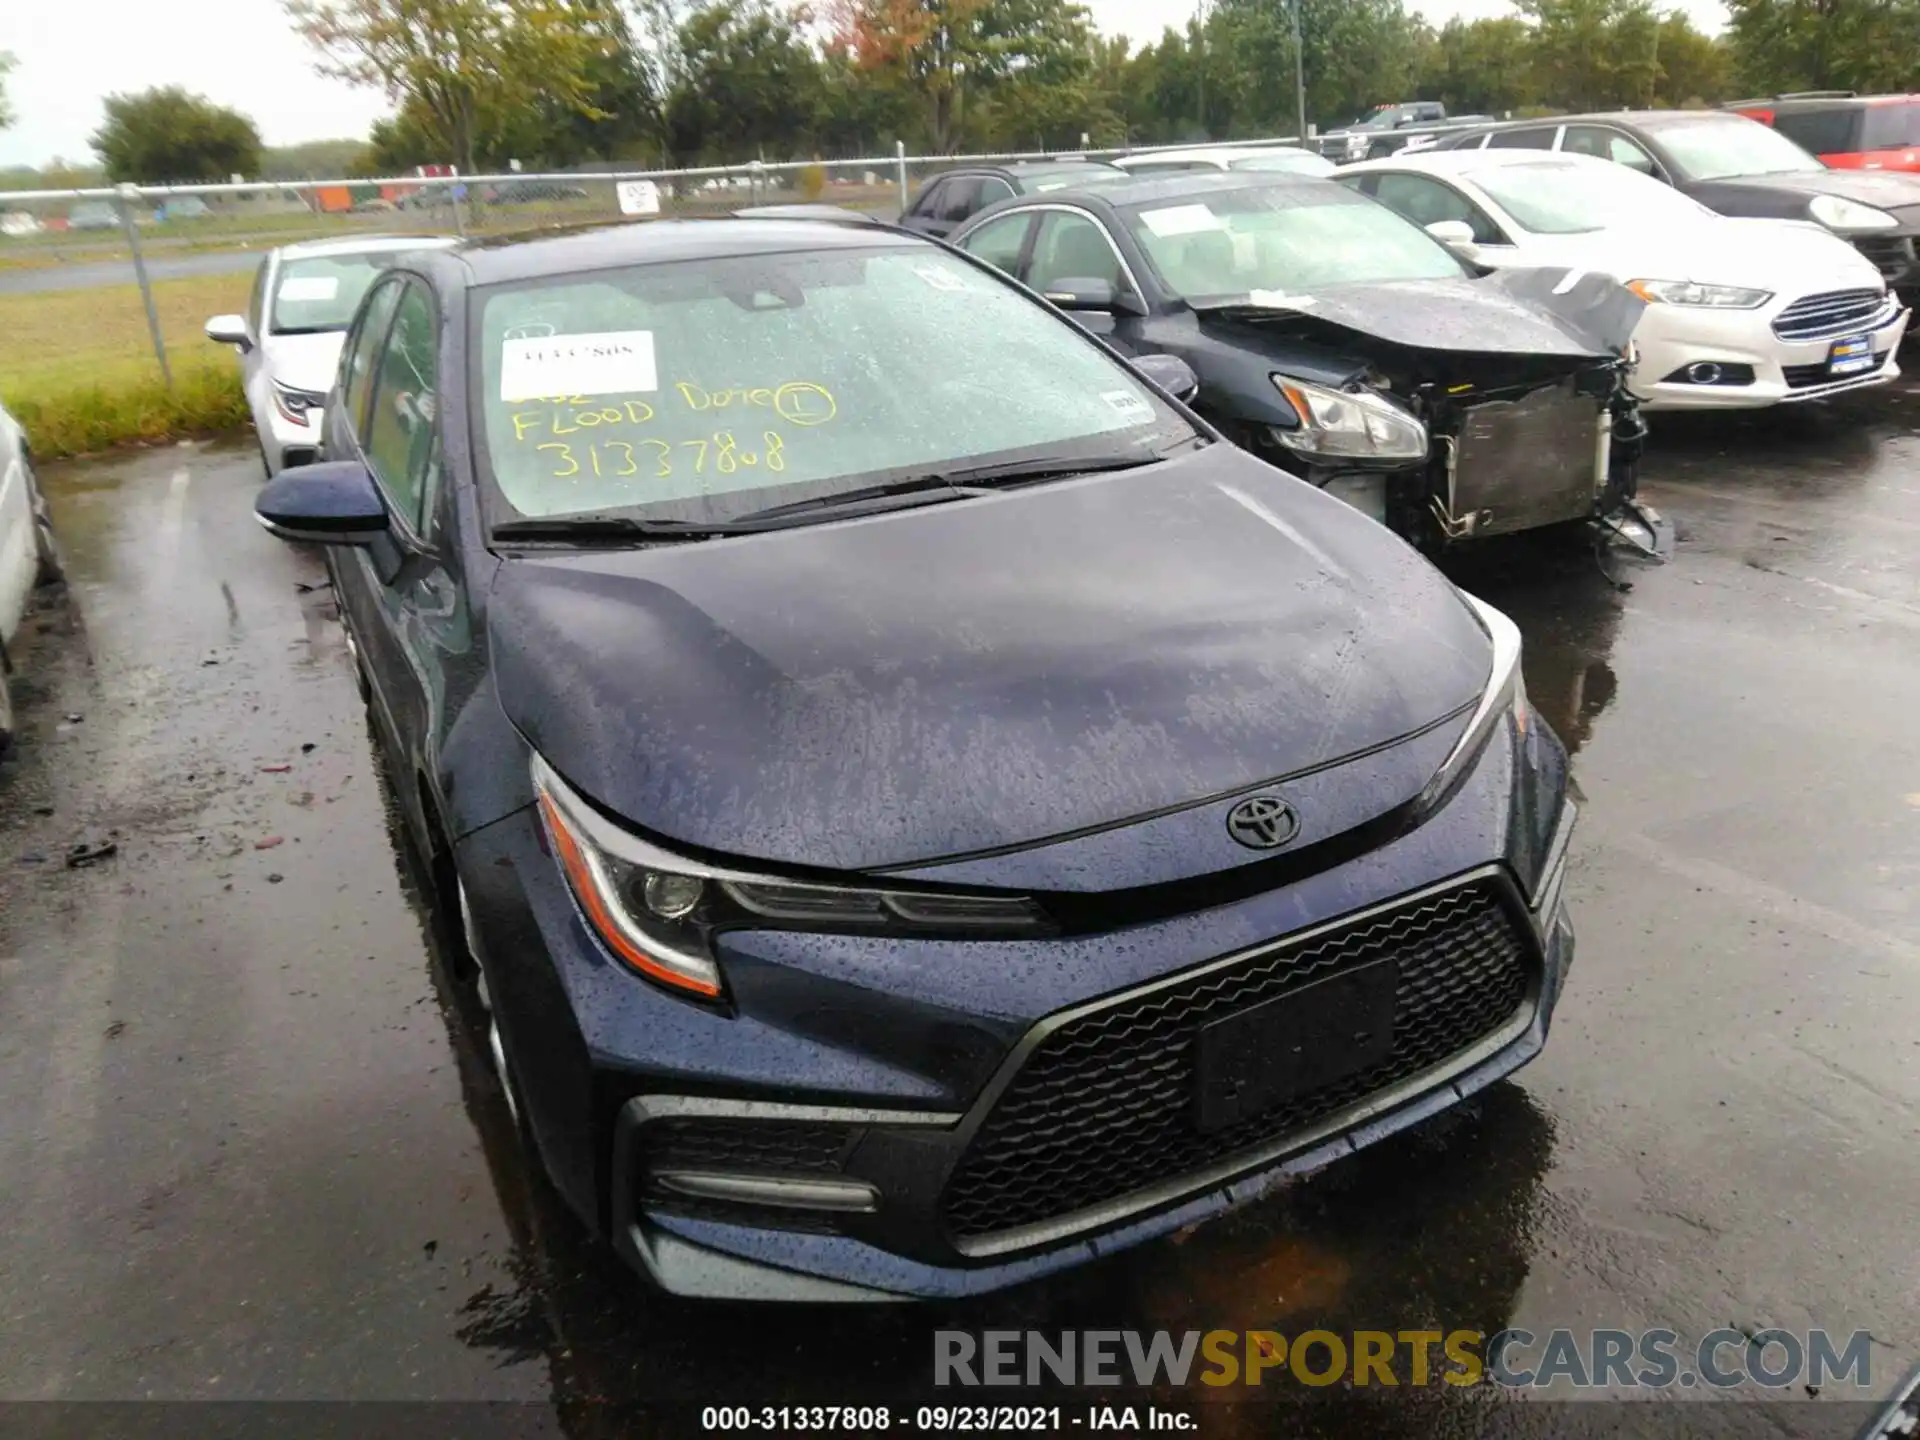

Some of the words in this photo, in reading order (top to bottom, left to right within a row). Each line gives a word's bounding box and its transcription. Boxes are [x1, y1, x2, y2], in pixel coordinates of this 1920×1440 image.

[511, 400, 654, 441] FLOOD
[675, 382, 774, 411] Done
[536, 430, 785, 478] 31337808
